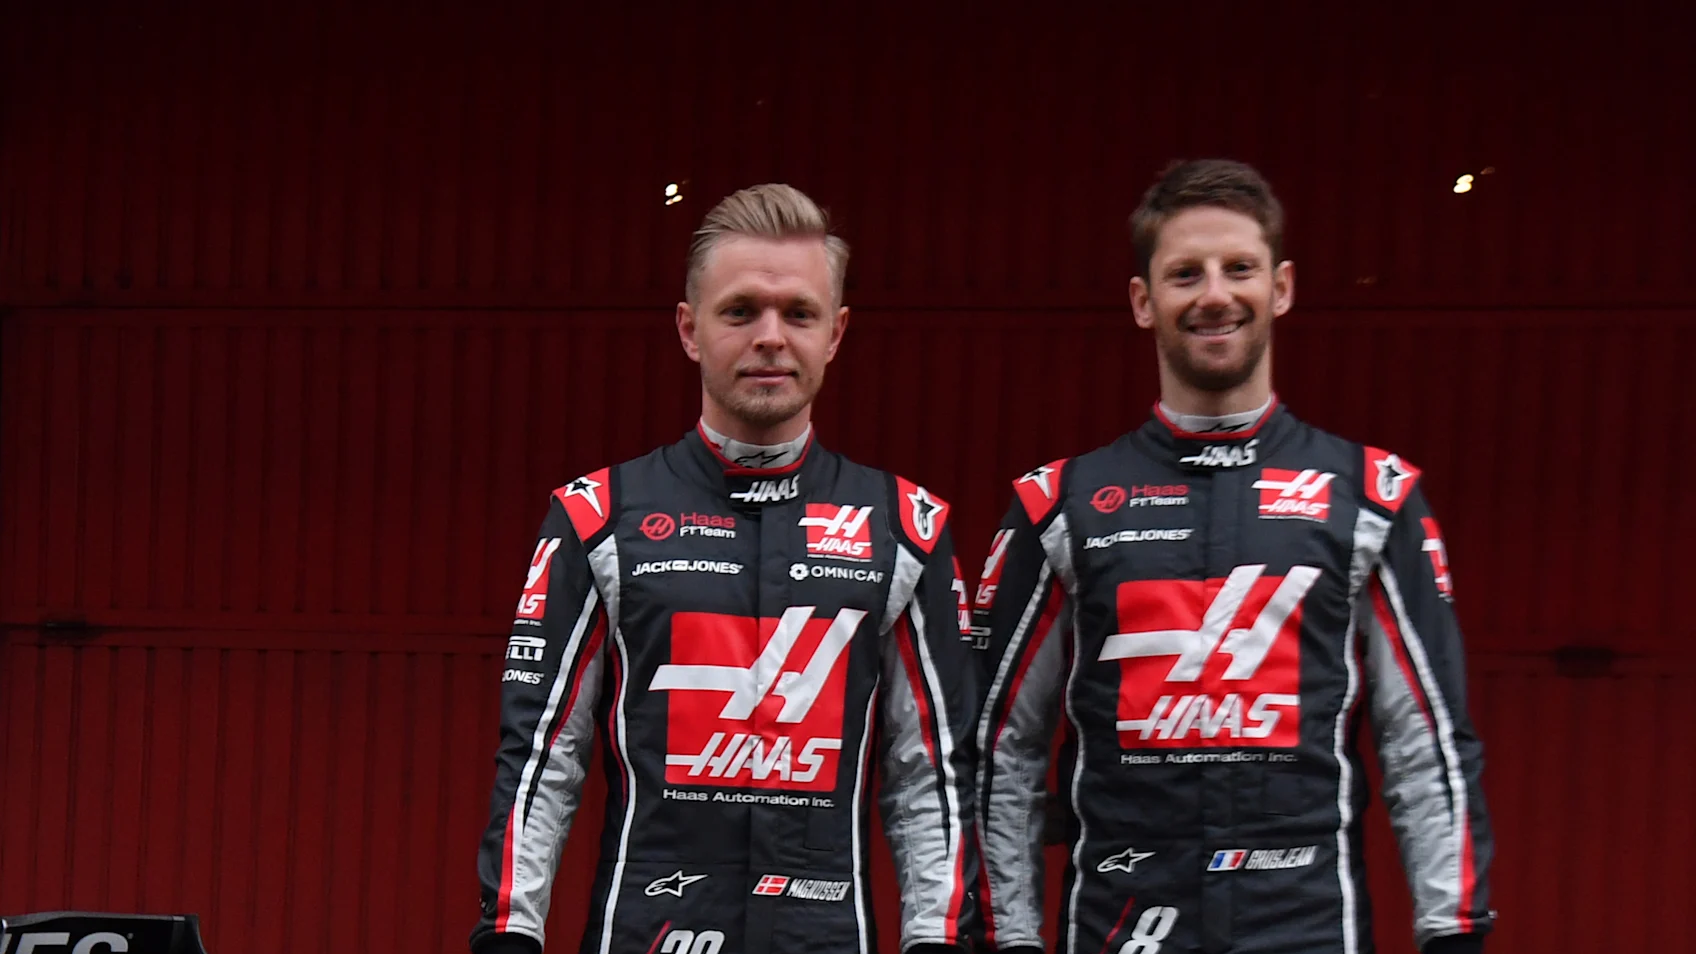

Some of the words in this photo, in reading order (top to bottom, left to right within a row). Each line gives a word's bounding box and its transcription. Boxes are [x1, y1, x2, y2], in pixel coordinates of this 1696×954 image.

[1179, 439, 1260, 467] HAAS
[730, 474, 800, 502] HAAS
[1131, 484, 1191, 497] Haas
[1258, 498, 1332, 515] HAAS
[680, 512, 736, 528] Haas
[696, 526, 736, 538] Team
[1083, 531, 1120, 549] JACK
[1134, 528, 1192, 541] JONES
[806, 537, 872, 555] HAAS
[632, 561, 672, 576] JACK
[688, 561, 741, 574] JONES
[1116, 693, 1301, 740] HAAS
[665, 732, 843, 783] HAAS
[1120, 753, 1161, 765] Haas
[1165, 751, 1264, 764] Automation
[1268, 752, 1298, 763] Inc.
[663, 789, 708, 802] Haas
[712, 791, 809, 807] Automation
[812, 797, 835, 808] Inc.
[1245, 846, 1319, 870] GROSJEAN
[786, 877, 851, 901] MAGNUSSEN
